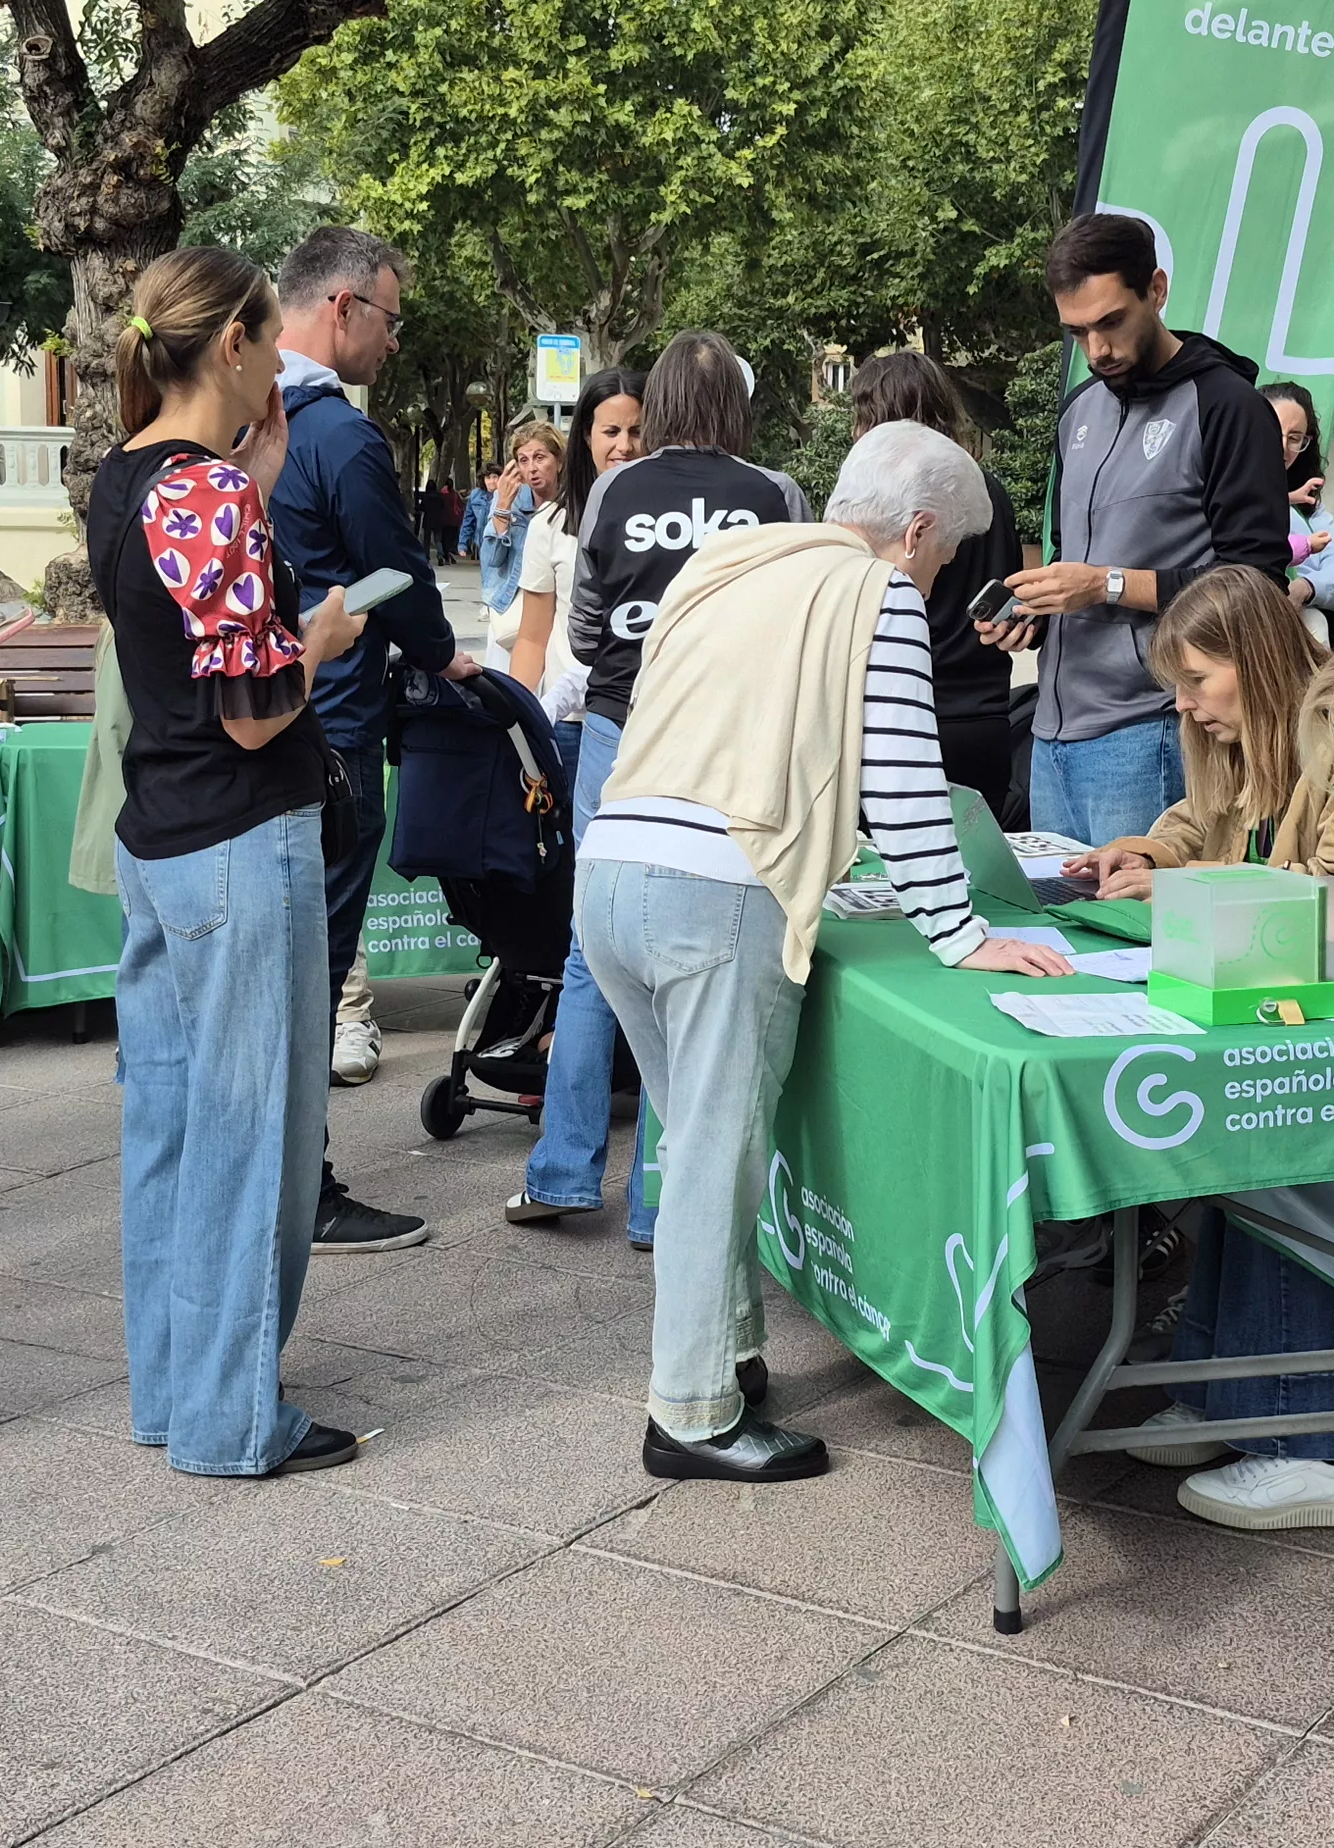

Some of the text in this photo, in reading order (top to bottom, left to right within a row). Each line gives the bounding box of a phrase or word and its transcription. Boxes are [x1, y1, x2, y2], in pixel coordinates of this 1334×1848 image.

[1184, 1, 1334, 58] delante
[367, 885, 447, 908] asociaci
[367, 934, 430, 953] contra
[434, 931, 452, 948] el
[1225, 1104, 1314, 1132] contra
